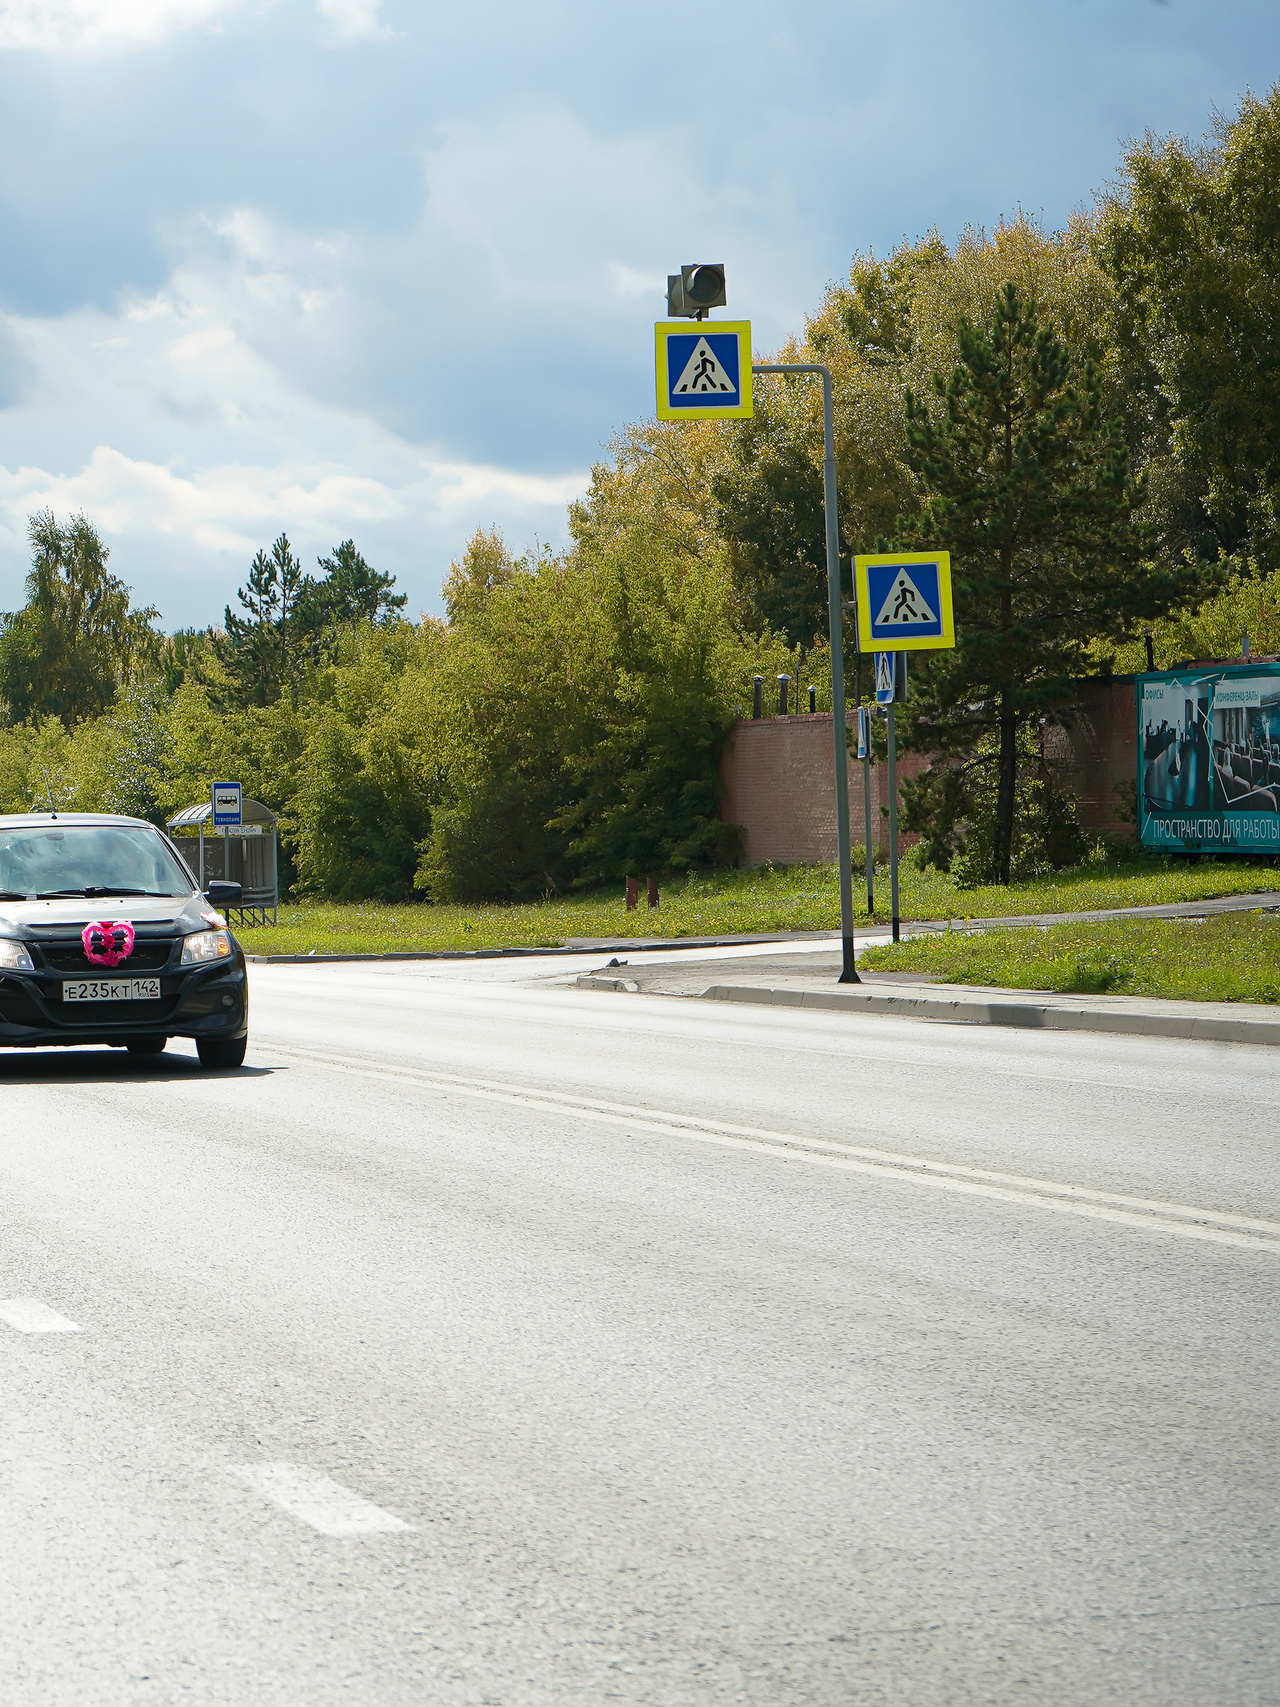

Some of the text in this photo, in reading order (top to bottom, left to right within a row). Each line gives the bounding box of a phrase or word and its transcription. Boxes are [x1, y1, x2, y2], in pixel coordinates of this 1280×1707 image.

[1145, 689, 1164, 700] ОФИСЫ
[1215, 690, 1260, 703] КОНФЕРЕНЦ-ЗАЛЫ
[1153, 819, 1280, 842] ПРОСТРАНСТВО ДЛЯ РАБОТЫ
[68, 980, 157, 999] Е235КТ 142
